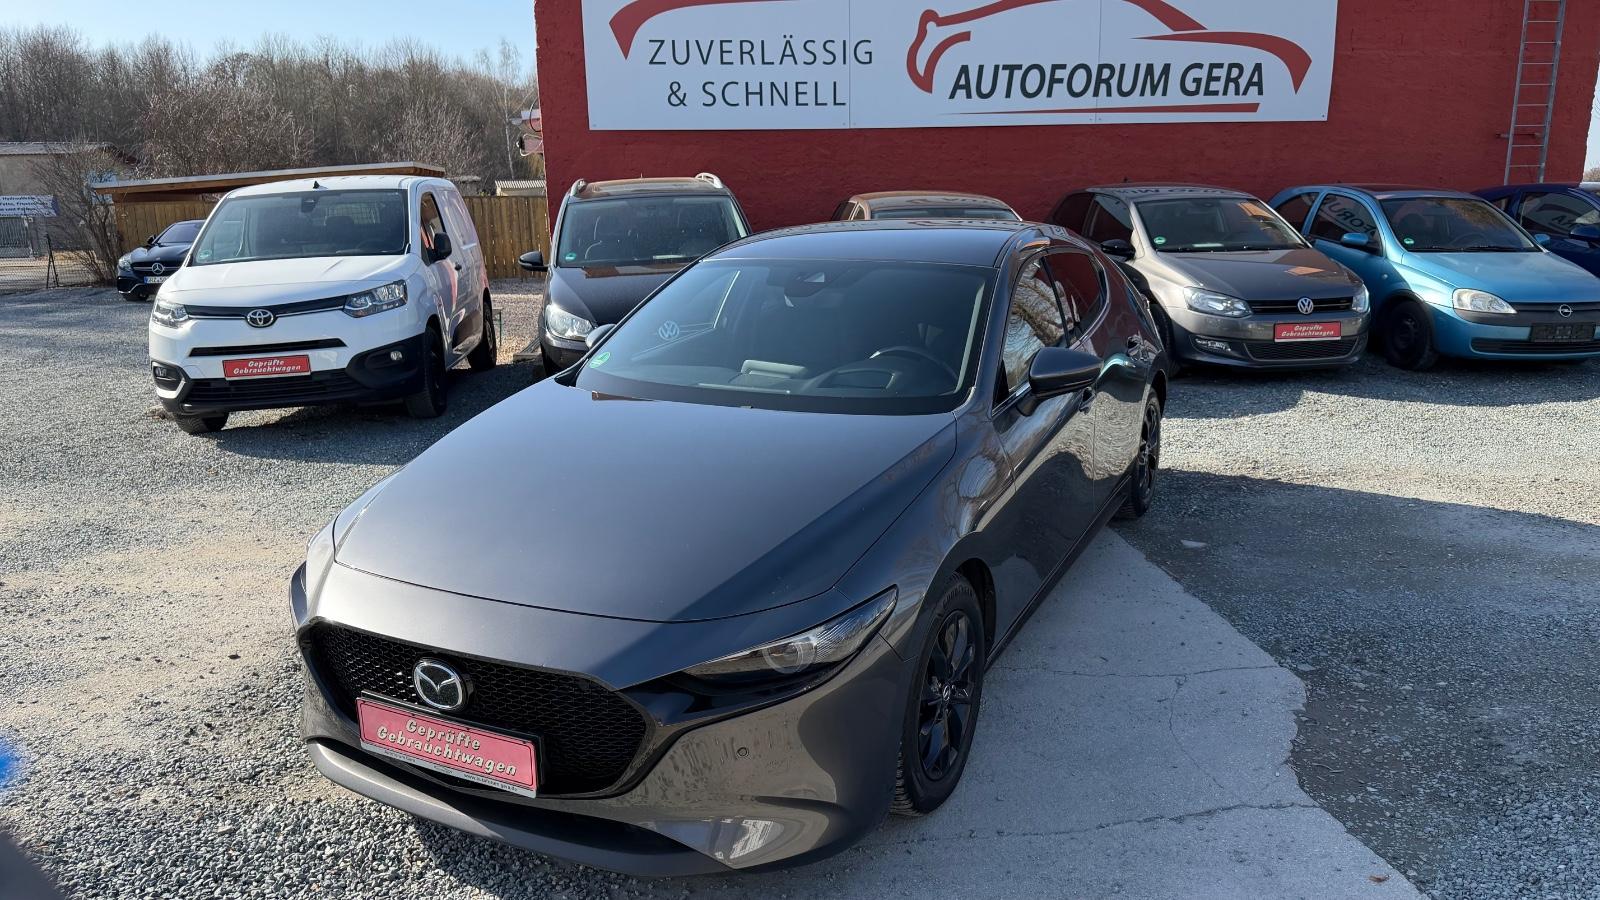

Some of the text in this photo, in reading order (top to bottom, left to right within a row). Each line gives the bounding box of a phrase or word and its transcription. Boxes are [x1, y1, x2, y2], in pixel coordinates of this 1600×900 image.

[648, 34, 874, 66] ZUVERLÄSSIG
[667, 80, 847, 107] & SCHNELL
[948, 62, 1265, 100] AUTOFORUM GERA
[233, 365, 301, 375] Gebrauchtwagen
[248, 359, 285, 368] Geprüfte
[406, 719, 481, 750] Geprüfte
[376, 726, 517, 776] Gebrauchtwagen
